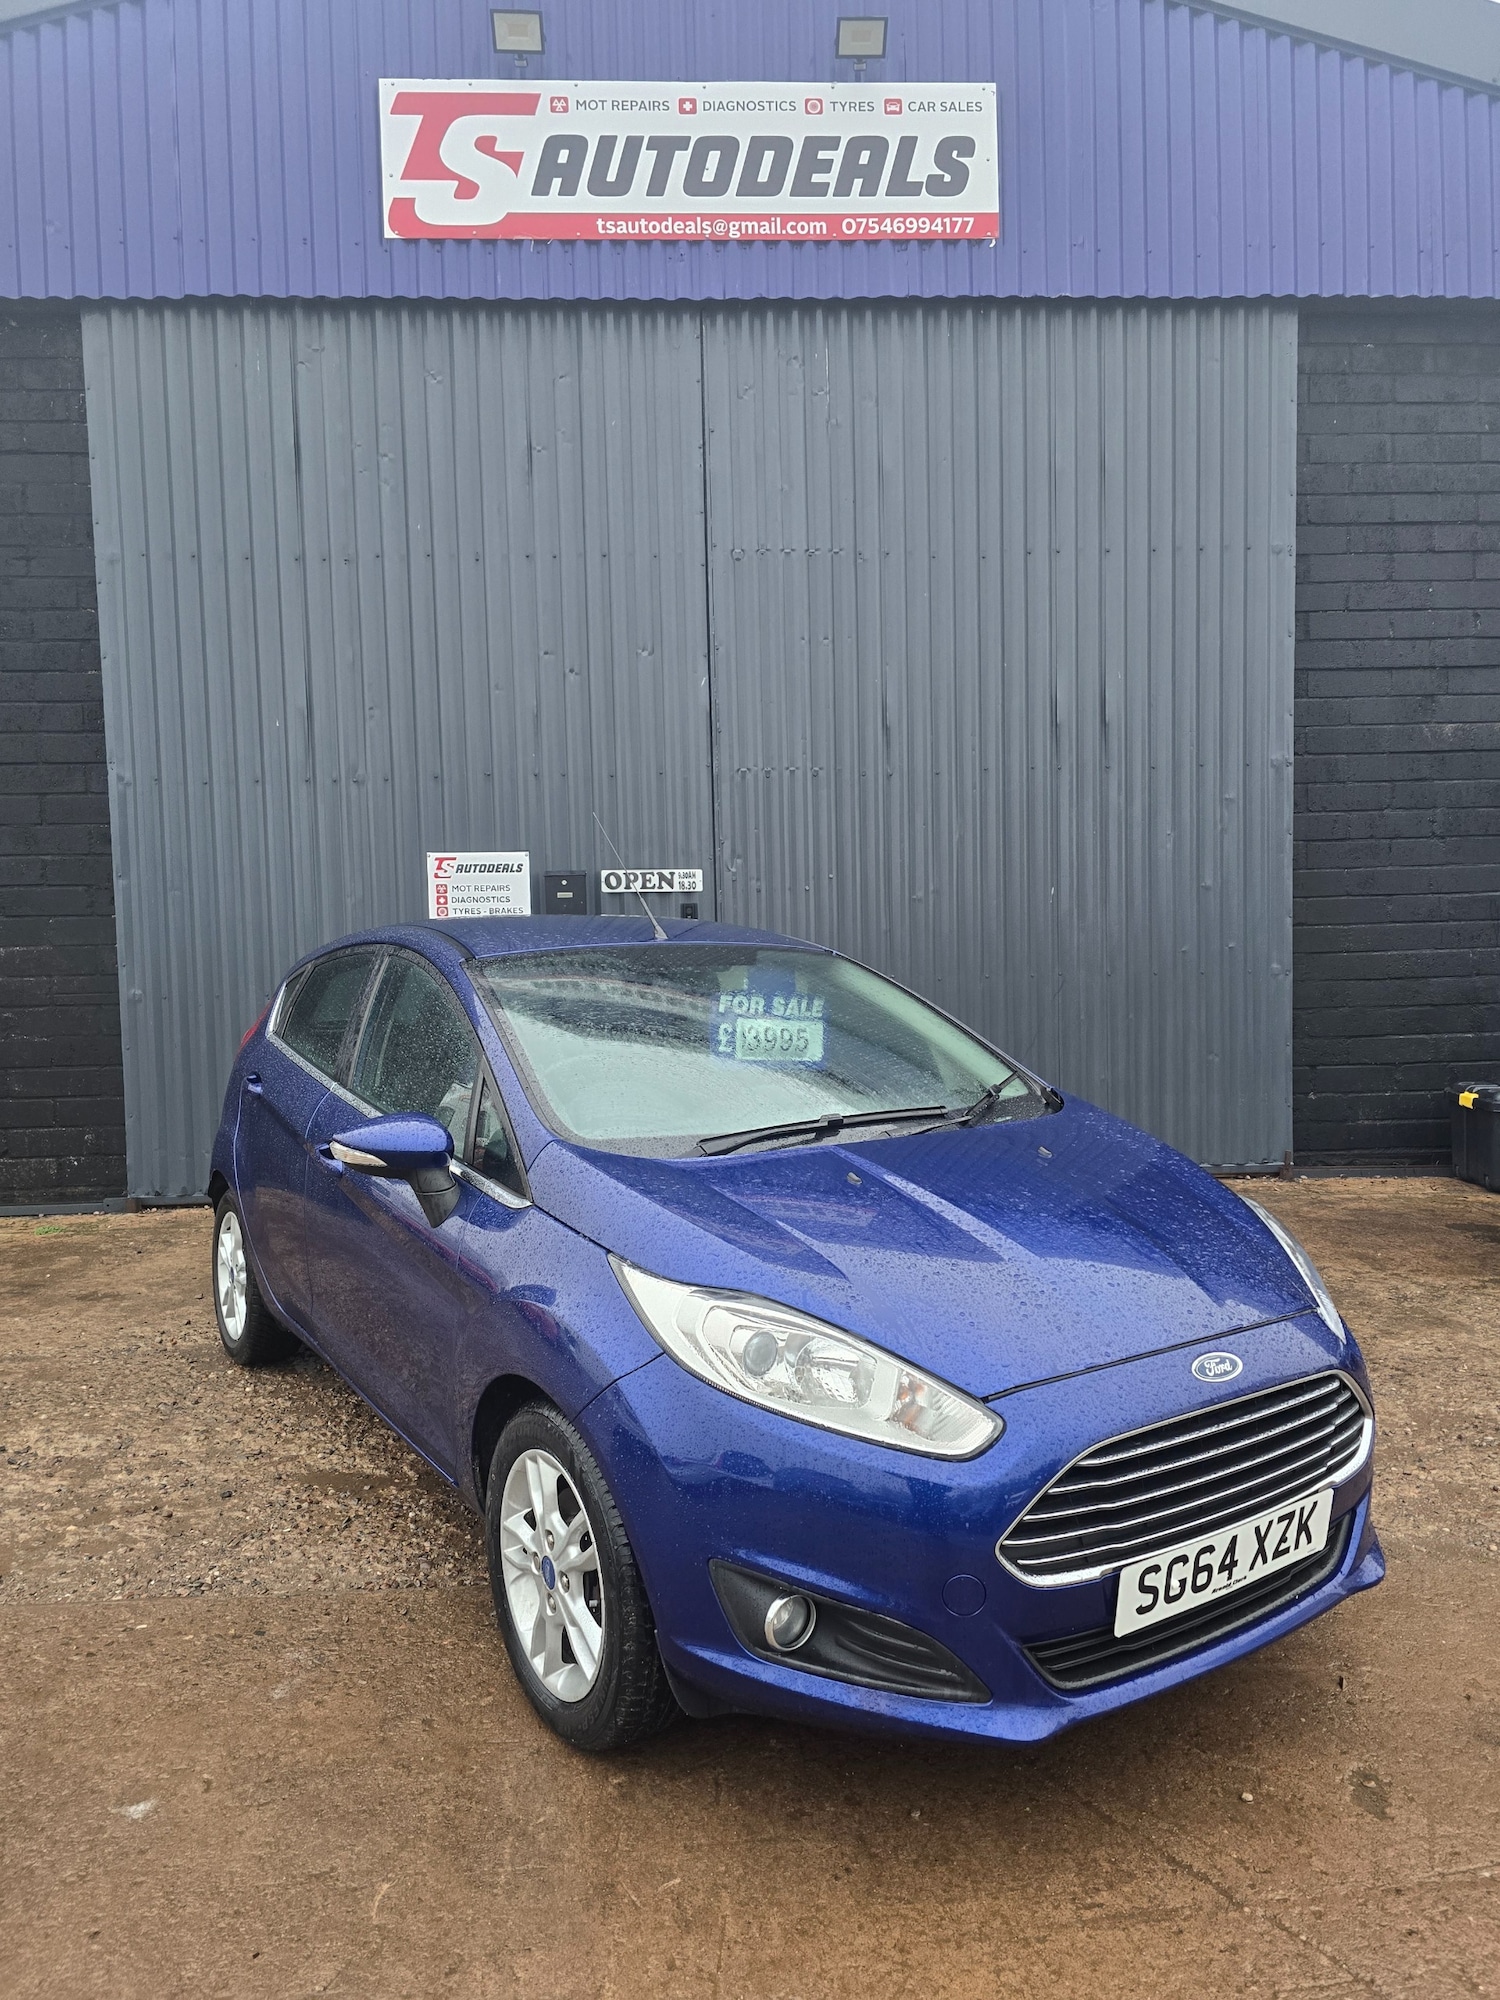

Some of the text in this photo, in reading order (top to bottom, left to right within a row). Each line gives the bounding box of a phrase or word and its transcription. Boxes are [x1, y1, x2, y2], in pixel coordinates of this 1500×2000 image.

[575, 99, 984, 113] MOT REPAIRS DIAGNOSTICS TYRES CAR SALES
[531, 134, 977, 198] AUTODEALS
[596, 217, 975, 238] tsautodeals@gmail.com 07546994177
[455, 863, 524, 874] AUTODEALS
[473, 884, 511, 892] REPAIRS
[604, 871, 676, 891] OPEN
[451, 896, 511, 904] DIAGNOSTICS
[452, 907, 482, 915] TYRES
[488, 906, 524, 915] BRAKES
[718, 993, 826, 1018] FOR SALE
[1204, 1358, 1232, 1376] Ford
[1136, 1501, 1318, 1615] SG64 XZK
